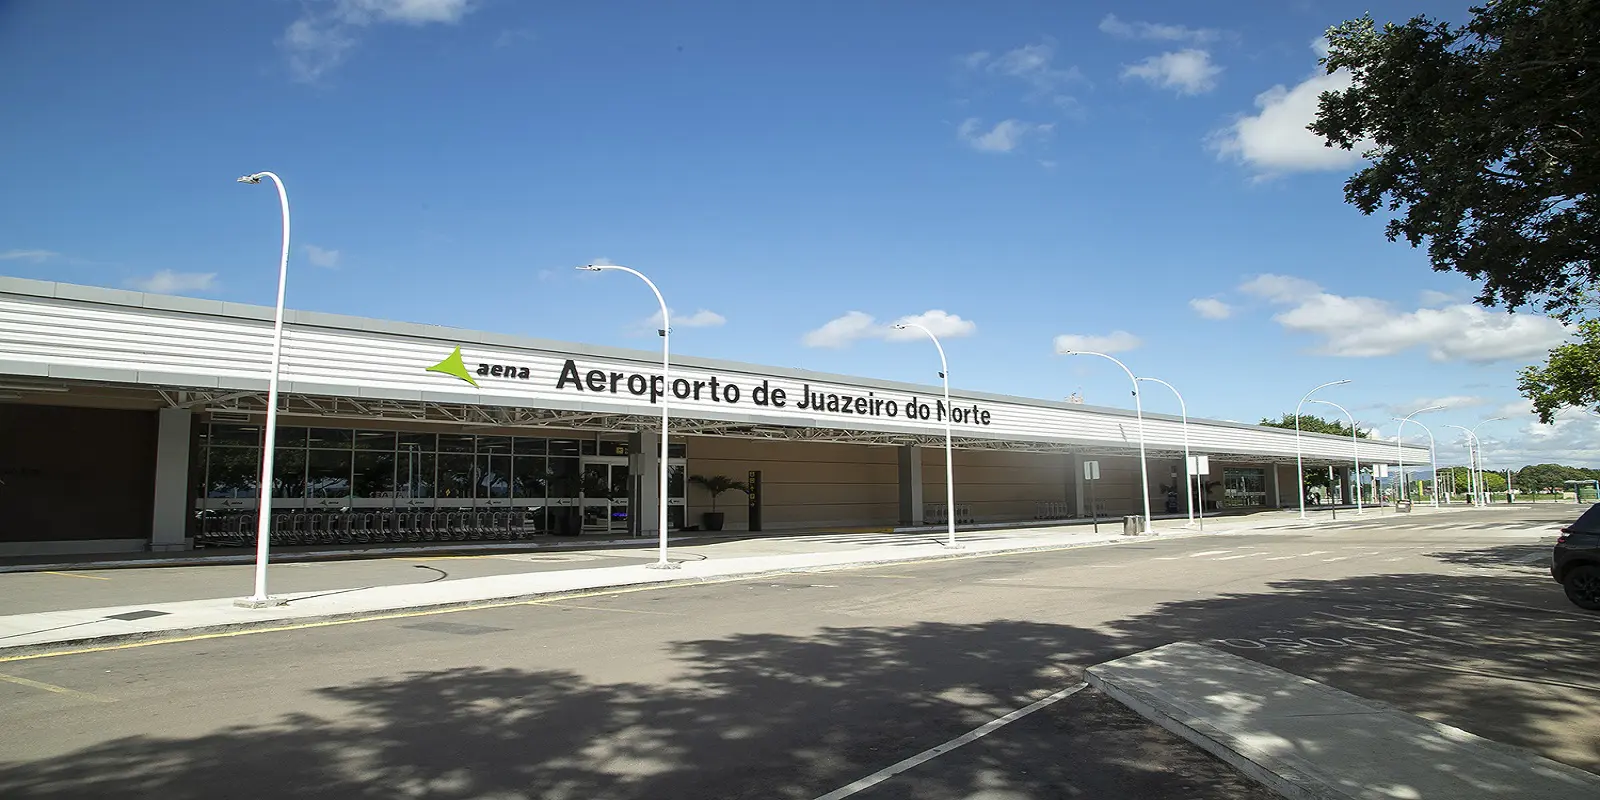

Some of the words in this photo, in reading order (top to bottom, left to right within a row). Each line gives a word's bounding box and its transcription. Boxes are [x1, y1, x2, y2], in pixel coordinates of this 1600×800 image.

[476, 363, 530, 379] aena
[556, 360, 740, 404] Aeroporto
[752, 380, 786, 406] de
[797, 384, 898, 417] Juazeiro
[906, 397, 930, 420] do
[937, 399, 991, 425] Norte
